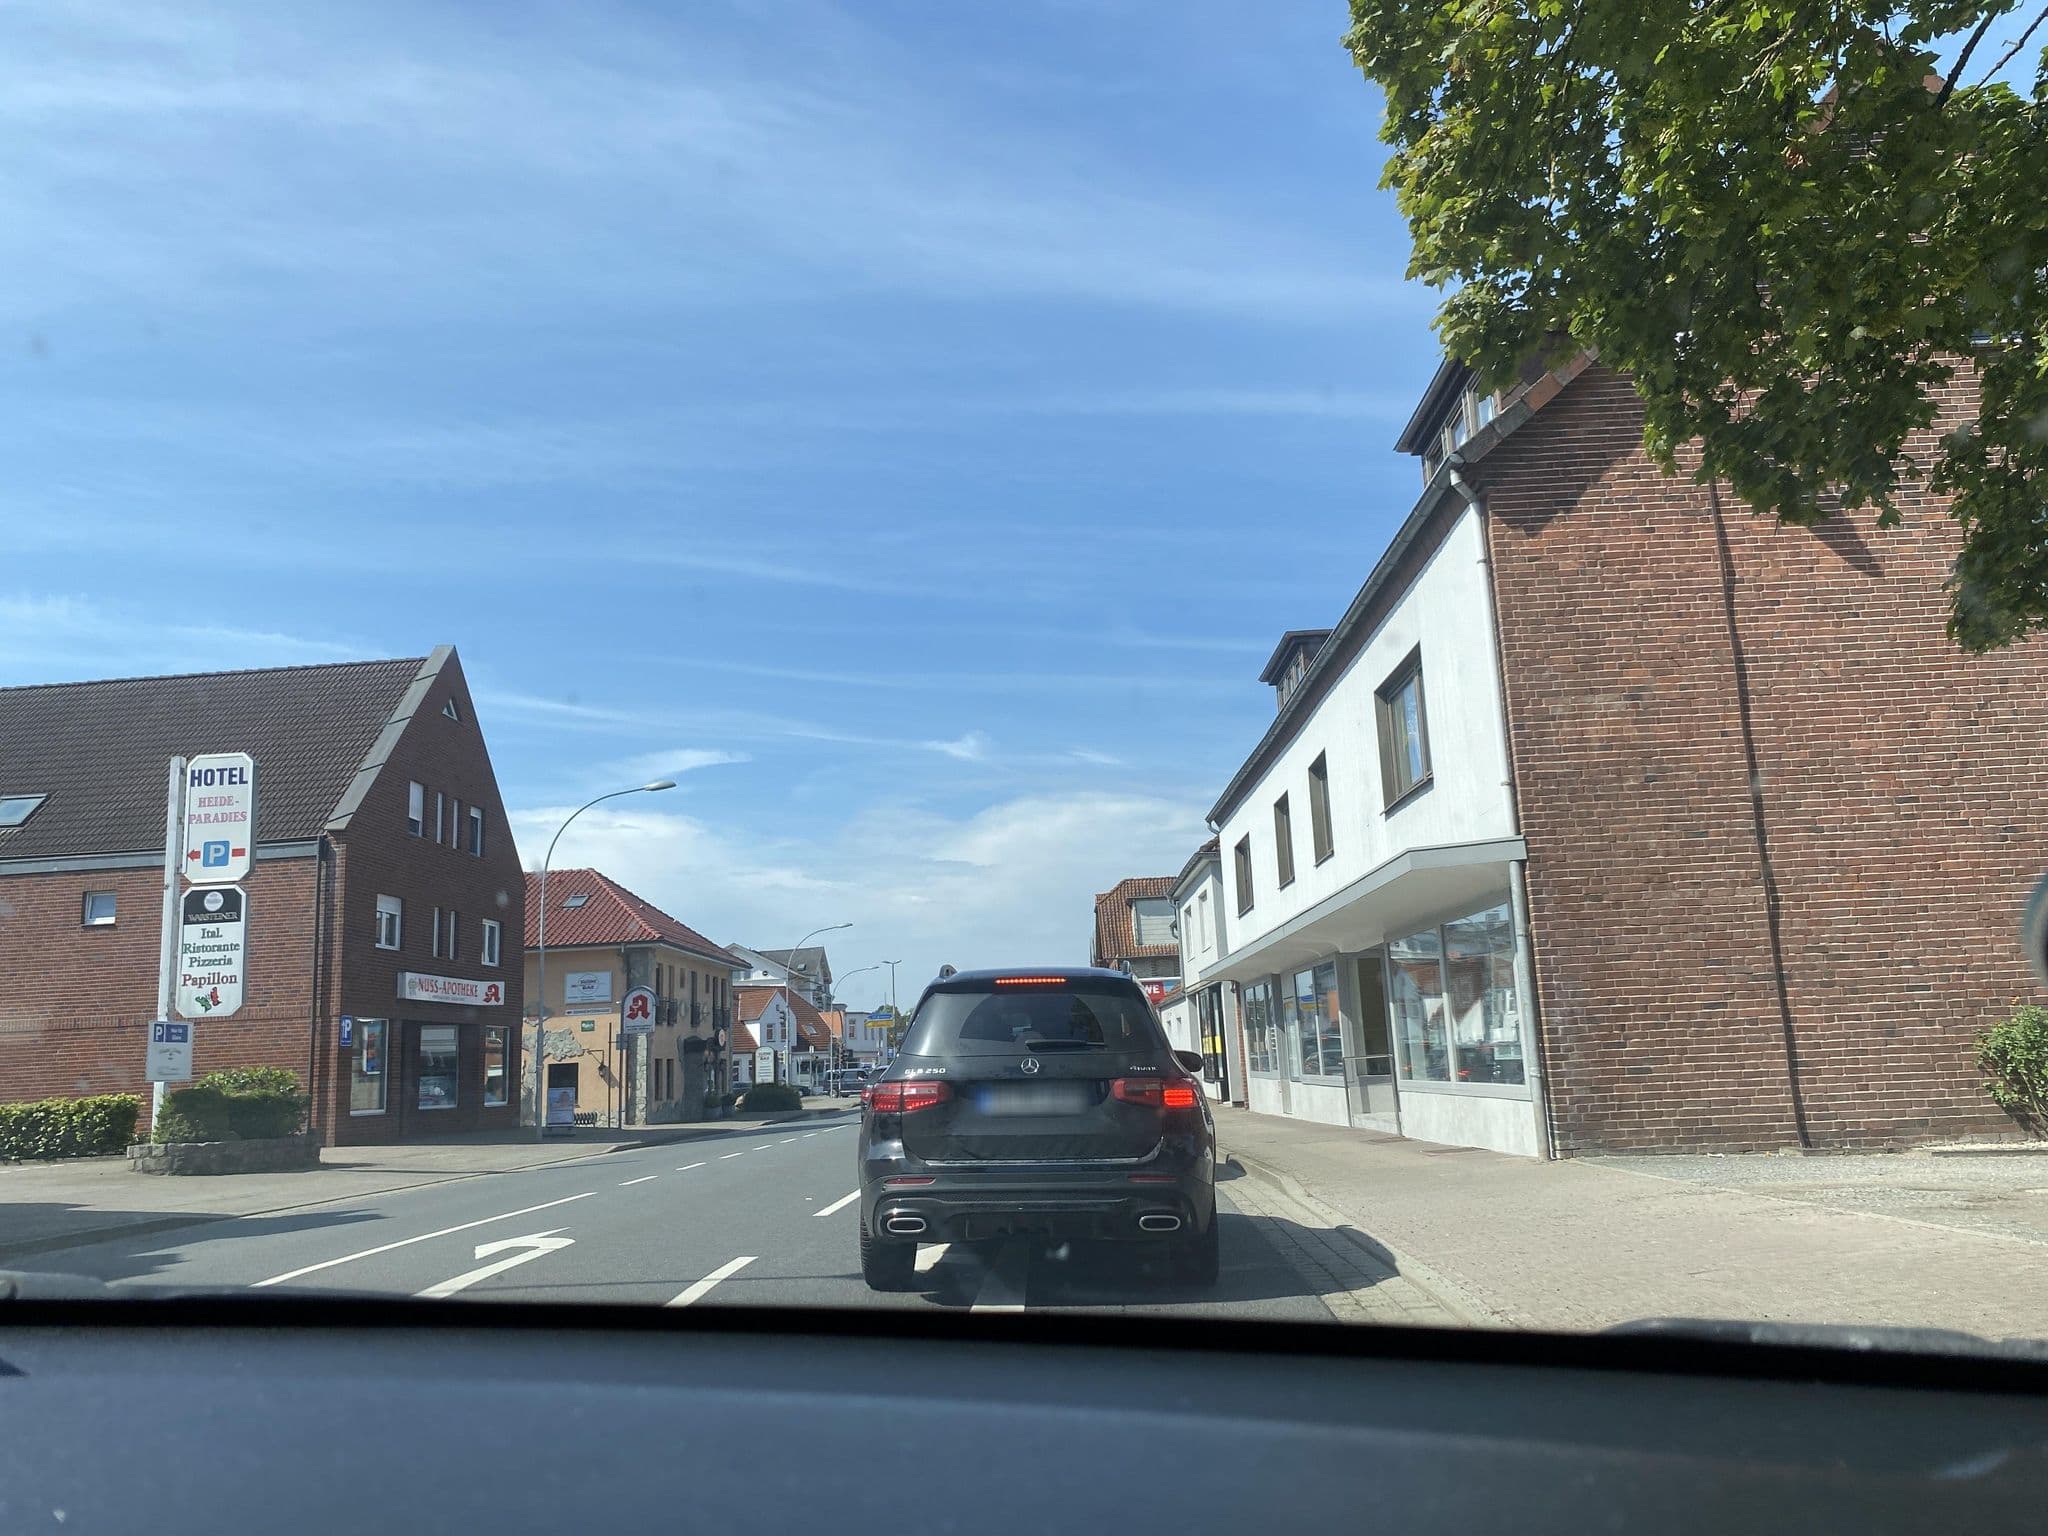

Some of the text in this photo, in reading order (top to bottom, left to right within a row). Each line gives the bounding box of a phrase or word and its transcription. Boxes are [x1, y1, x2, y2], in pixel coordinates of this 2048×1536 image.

[190, 767, 248, 787] HOTEL
[198, 796, 239, 808] HEIDE-
[189, 811, 247, 824] PARADIES
[188, 911, 238, 921] WARSTEINER
[200, 928, 223, 939] Ital.
[183, 942, 240, 954] Ristorante
[188, 955, 233, 967] Pizzeria
[182, 972, 237, 988] Papillon
[418, 978, 478, 997] NUSS-APOTHEKE
